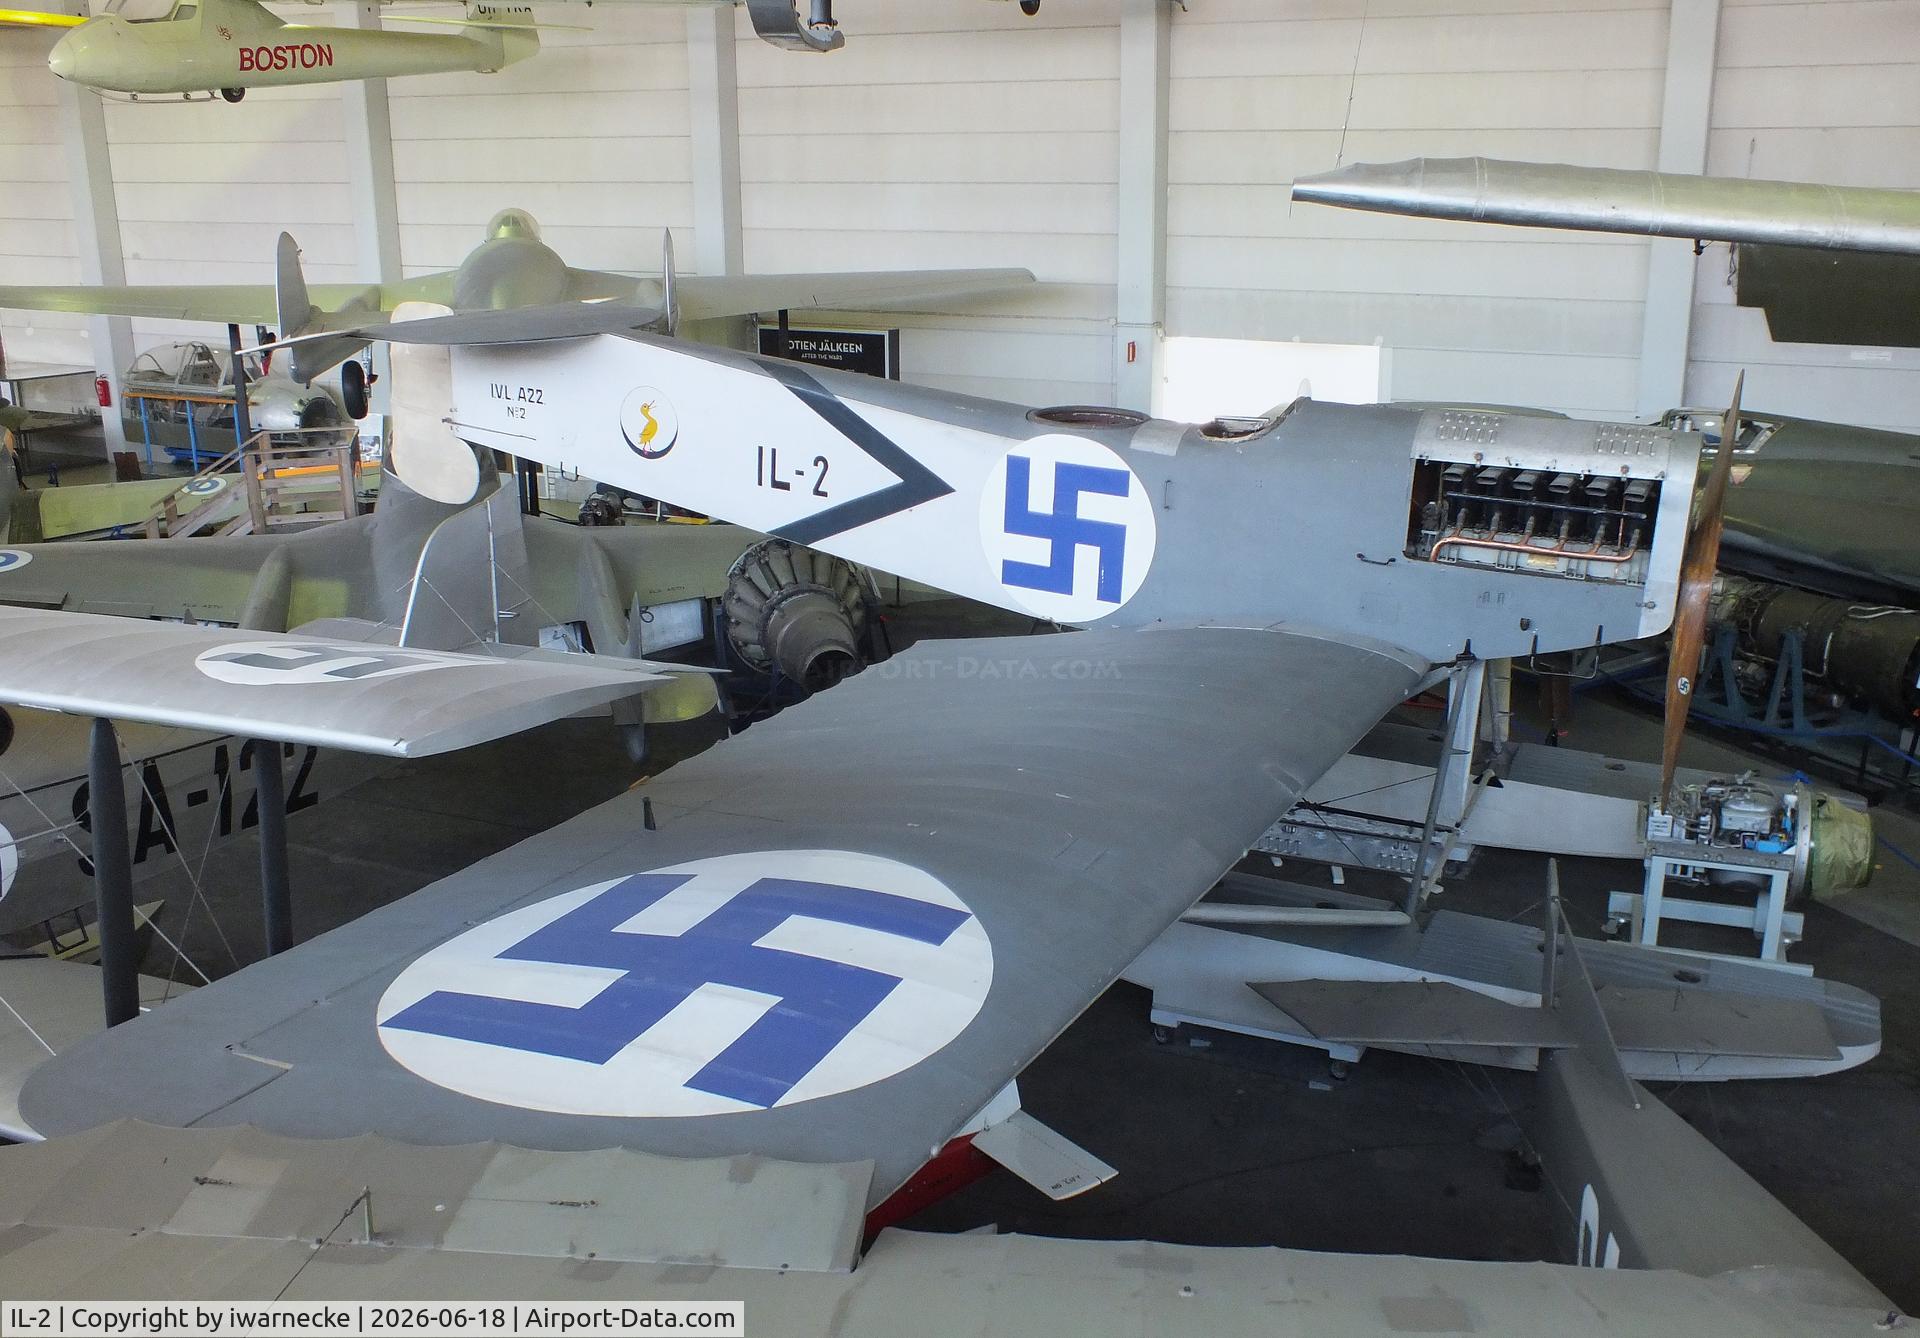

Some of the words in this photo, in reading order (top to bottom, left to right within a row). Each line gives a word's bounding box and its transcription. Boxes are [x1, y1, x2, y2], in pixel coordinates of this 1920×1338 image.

[239, 43, 333, 72] BOSTON
[818, 339, 863, 353] JÄLKEEN
[757, 445, 829, 498] IL-2
